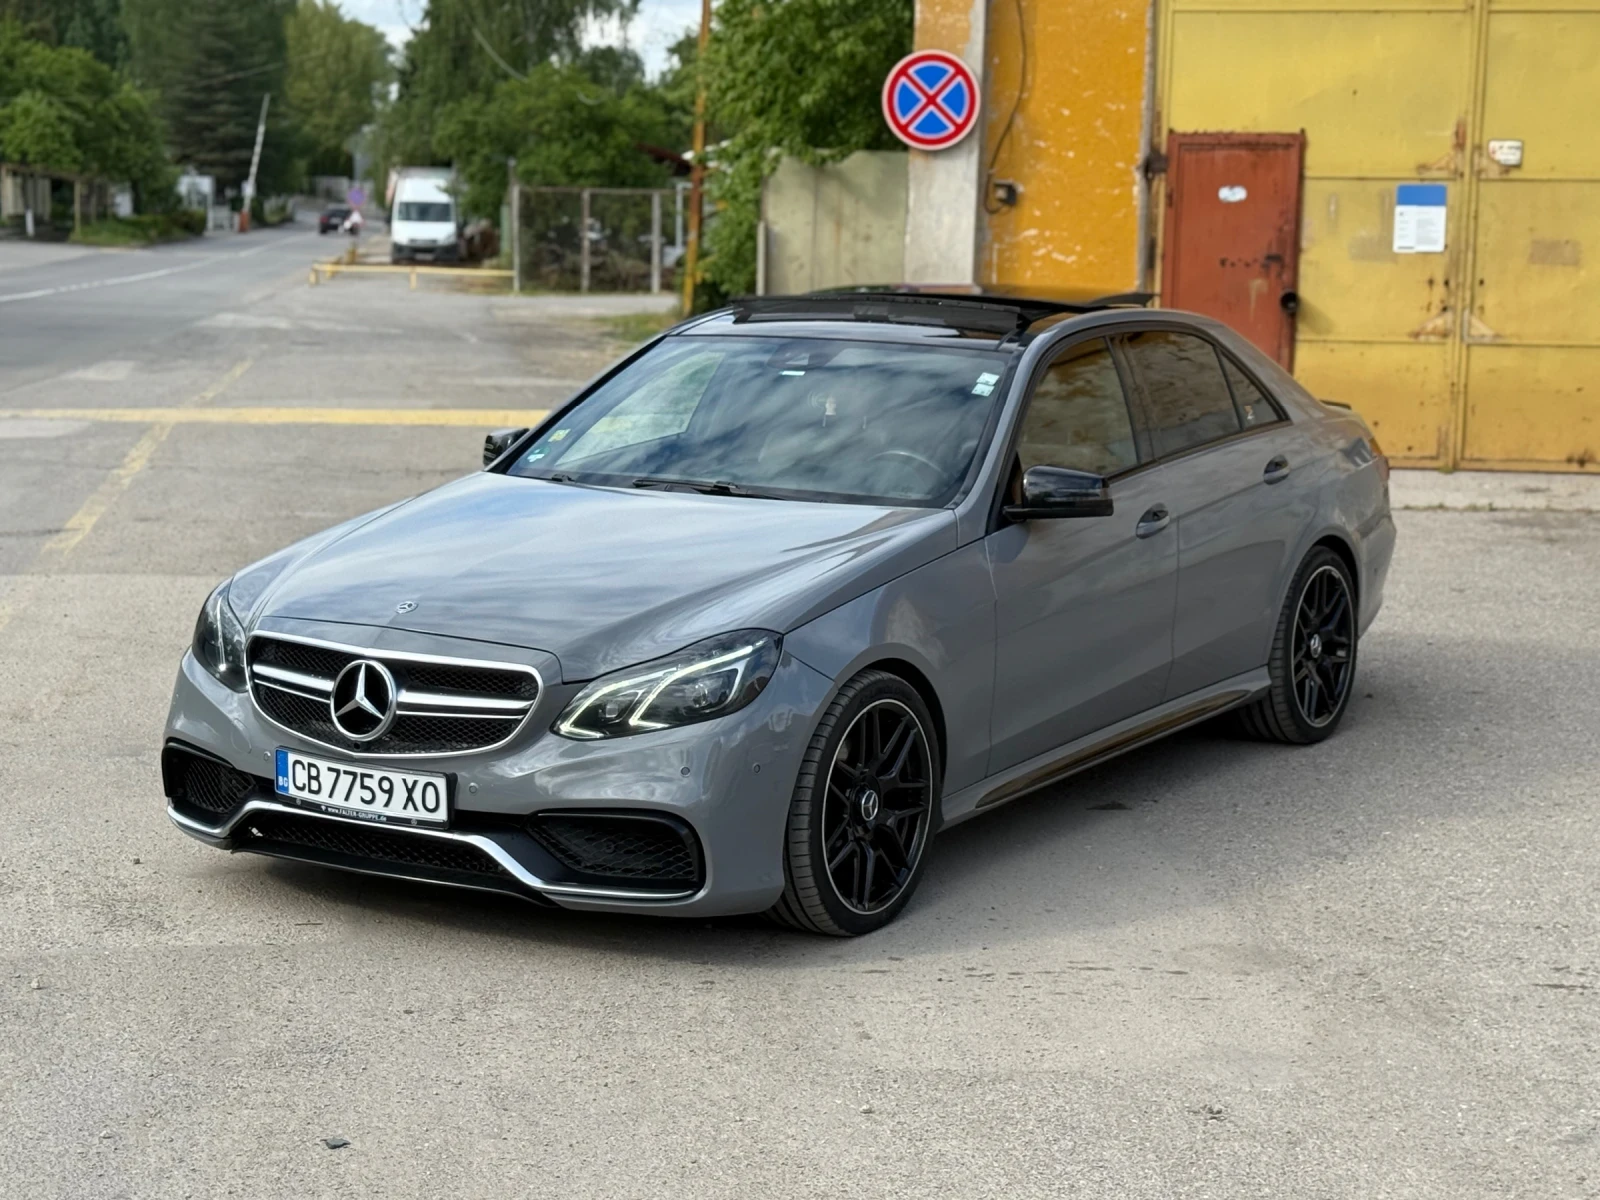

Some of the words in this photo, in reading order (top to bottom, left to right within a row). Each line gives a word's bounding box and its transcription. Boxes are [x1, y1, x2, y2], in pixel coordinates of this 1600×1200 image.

[278, 775, 288, 786] BG
[292, 759, 322, 795] CB
[327, 767, 394, 807] 7759
[401, 778, 440, 813] XO
